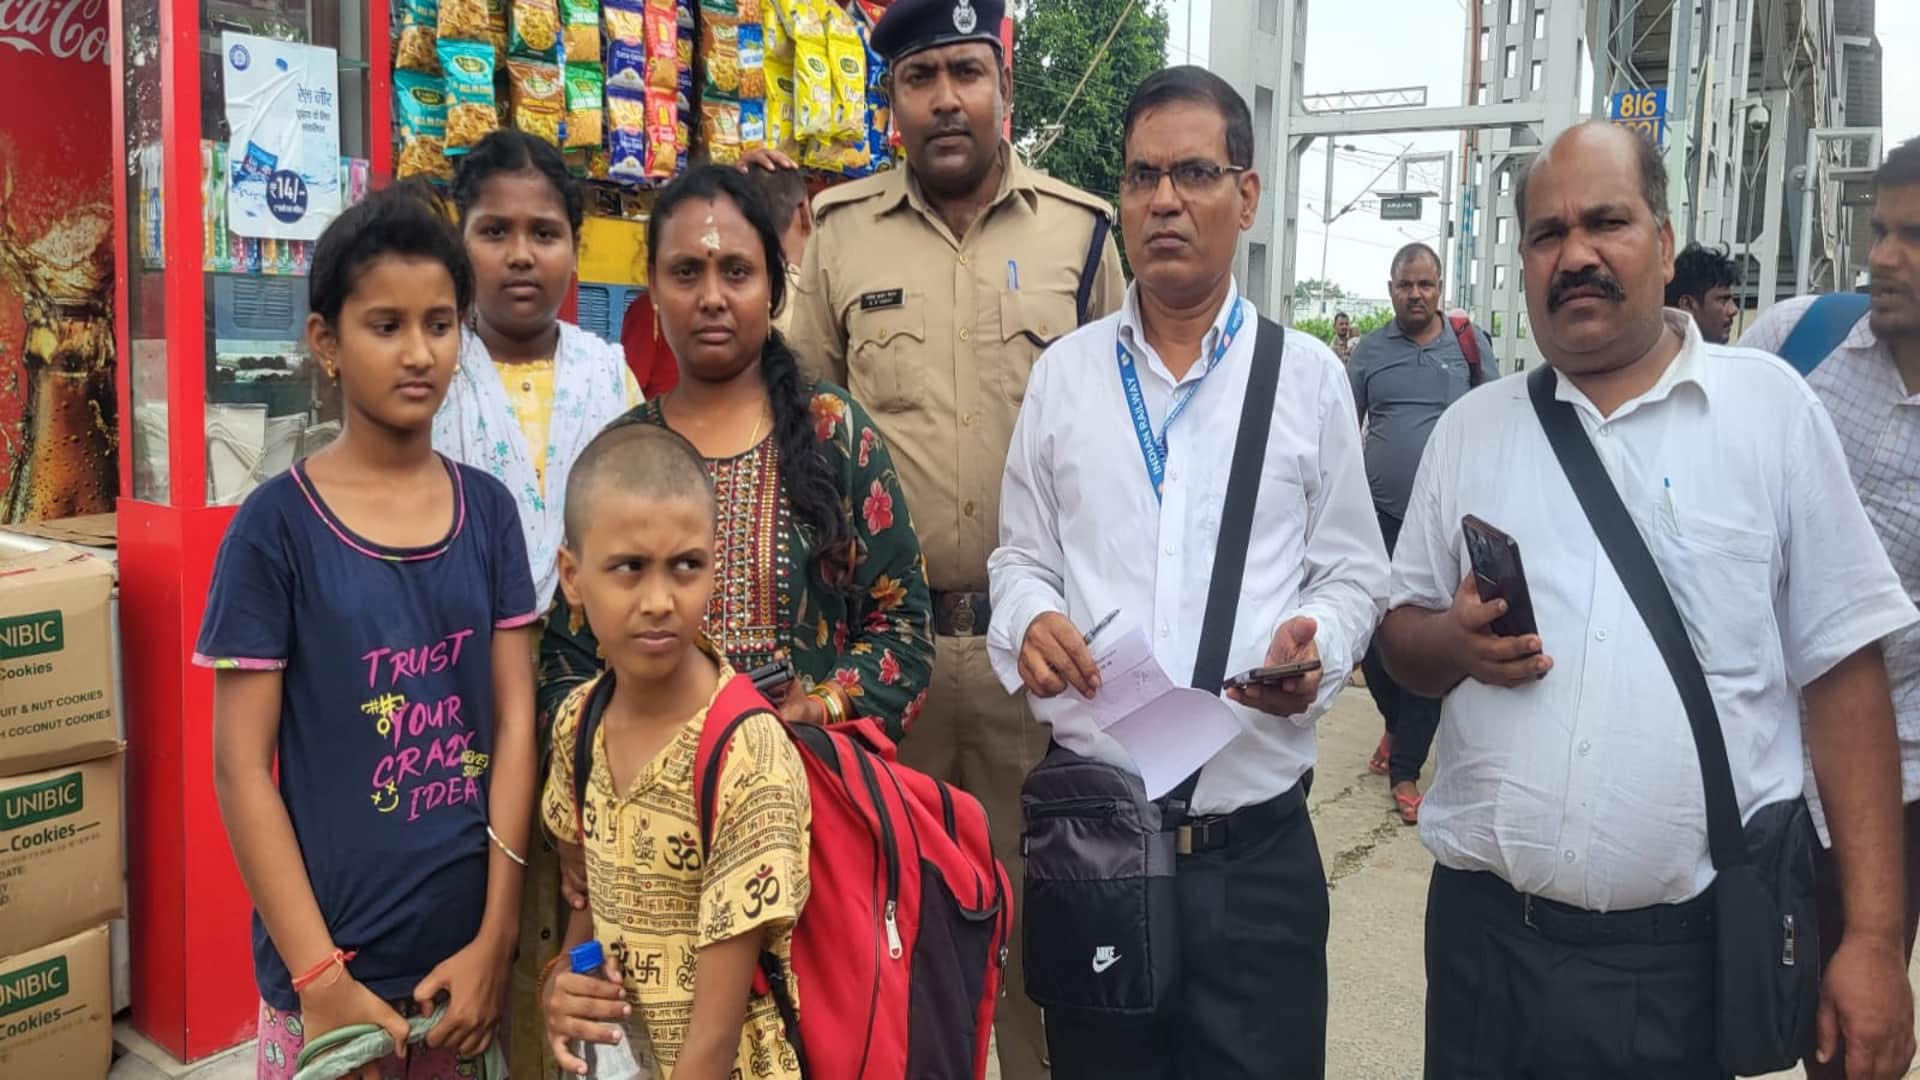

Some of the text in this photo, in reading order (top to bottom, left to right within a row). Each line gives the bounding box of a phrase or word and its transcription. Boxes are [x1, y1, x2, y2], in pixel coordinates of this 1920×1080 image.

[1620, 91, 1658, 118] 816
[1125, 376, 1150, 431] RAILWAY
[1142, 428, 1163, 475] INDIAN
[361, 629, 475, 689] TRUST
[21, 704, 29, 714] &
[31, 699, 54, 713] NUT
[56, 688, 104, 708] COOKIES
[8, 719, 64, 739] COCONUT
[65, 708, 112, 728] COOKIES
[390, 695, 465, 751] YOUR
[372, 730, 476, 790] CRAZY
[6, 782, 78, 820] UNIBIC
[408, 775, 480, 822] IDEA
[10, 824, 77, 853] Cookies
[1096, 946, 1115, 961] NIKE
